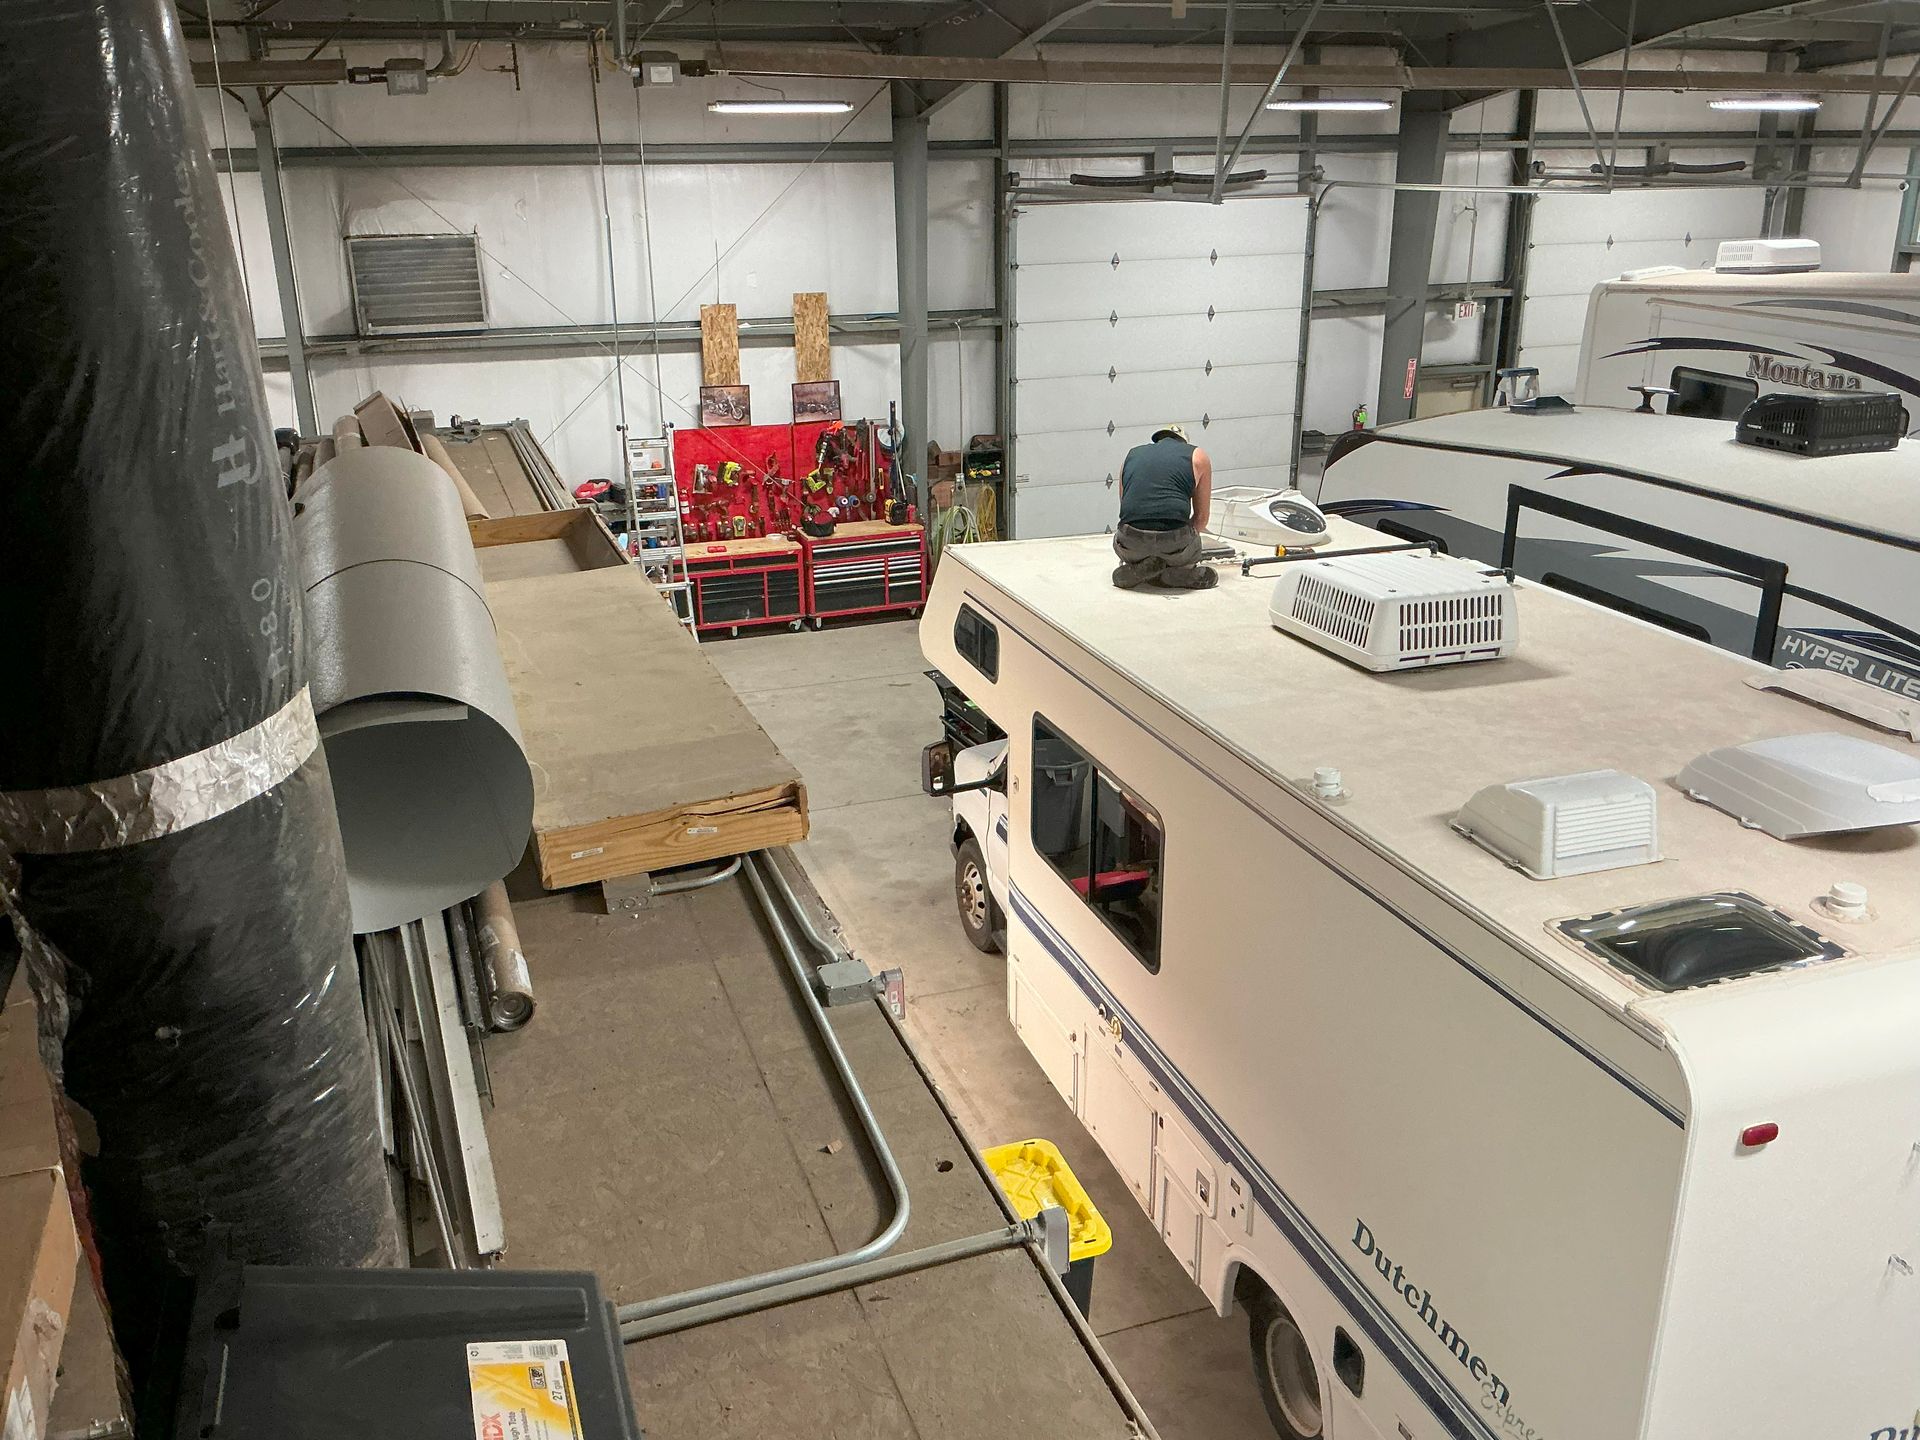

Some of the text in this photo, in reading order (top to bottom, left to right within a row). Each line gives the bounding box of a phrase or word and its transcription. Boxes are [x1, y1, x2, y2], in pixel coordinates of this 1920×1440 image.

[1458, 303, 1475, 318] EXIT
[1746, 354, 1863, 390] Montana
[1781, 635, 1920, 698] HYPER LITE
[1351, 1217, 1511, 1408] Dutchmen
[552, 1390, 563, 1401] 27
[553, 1379, 563, 1390] gal
